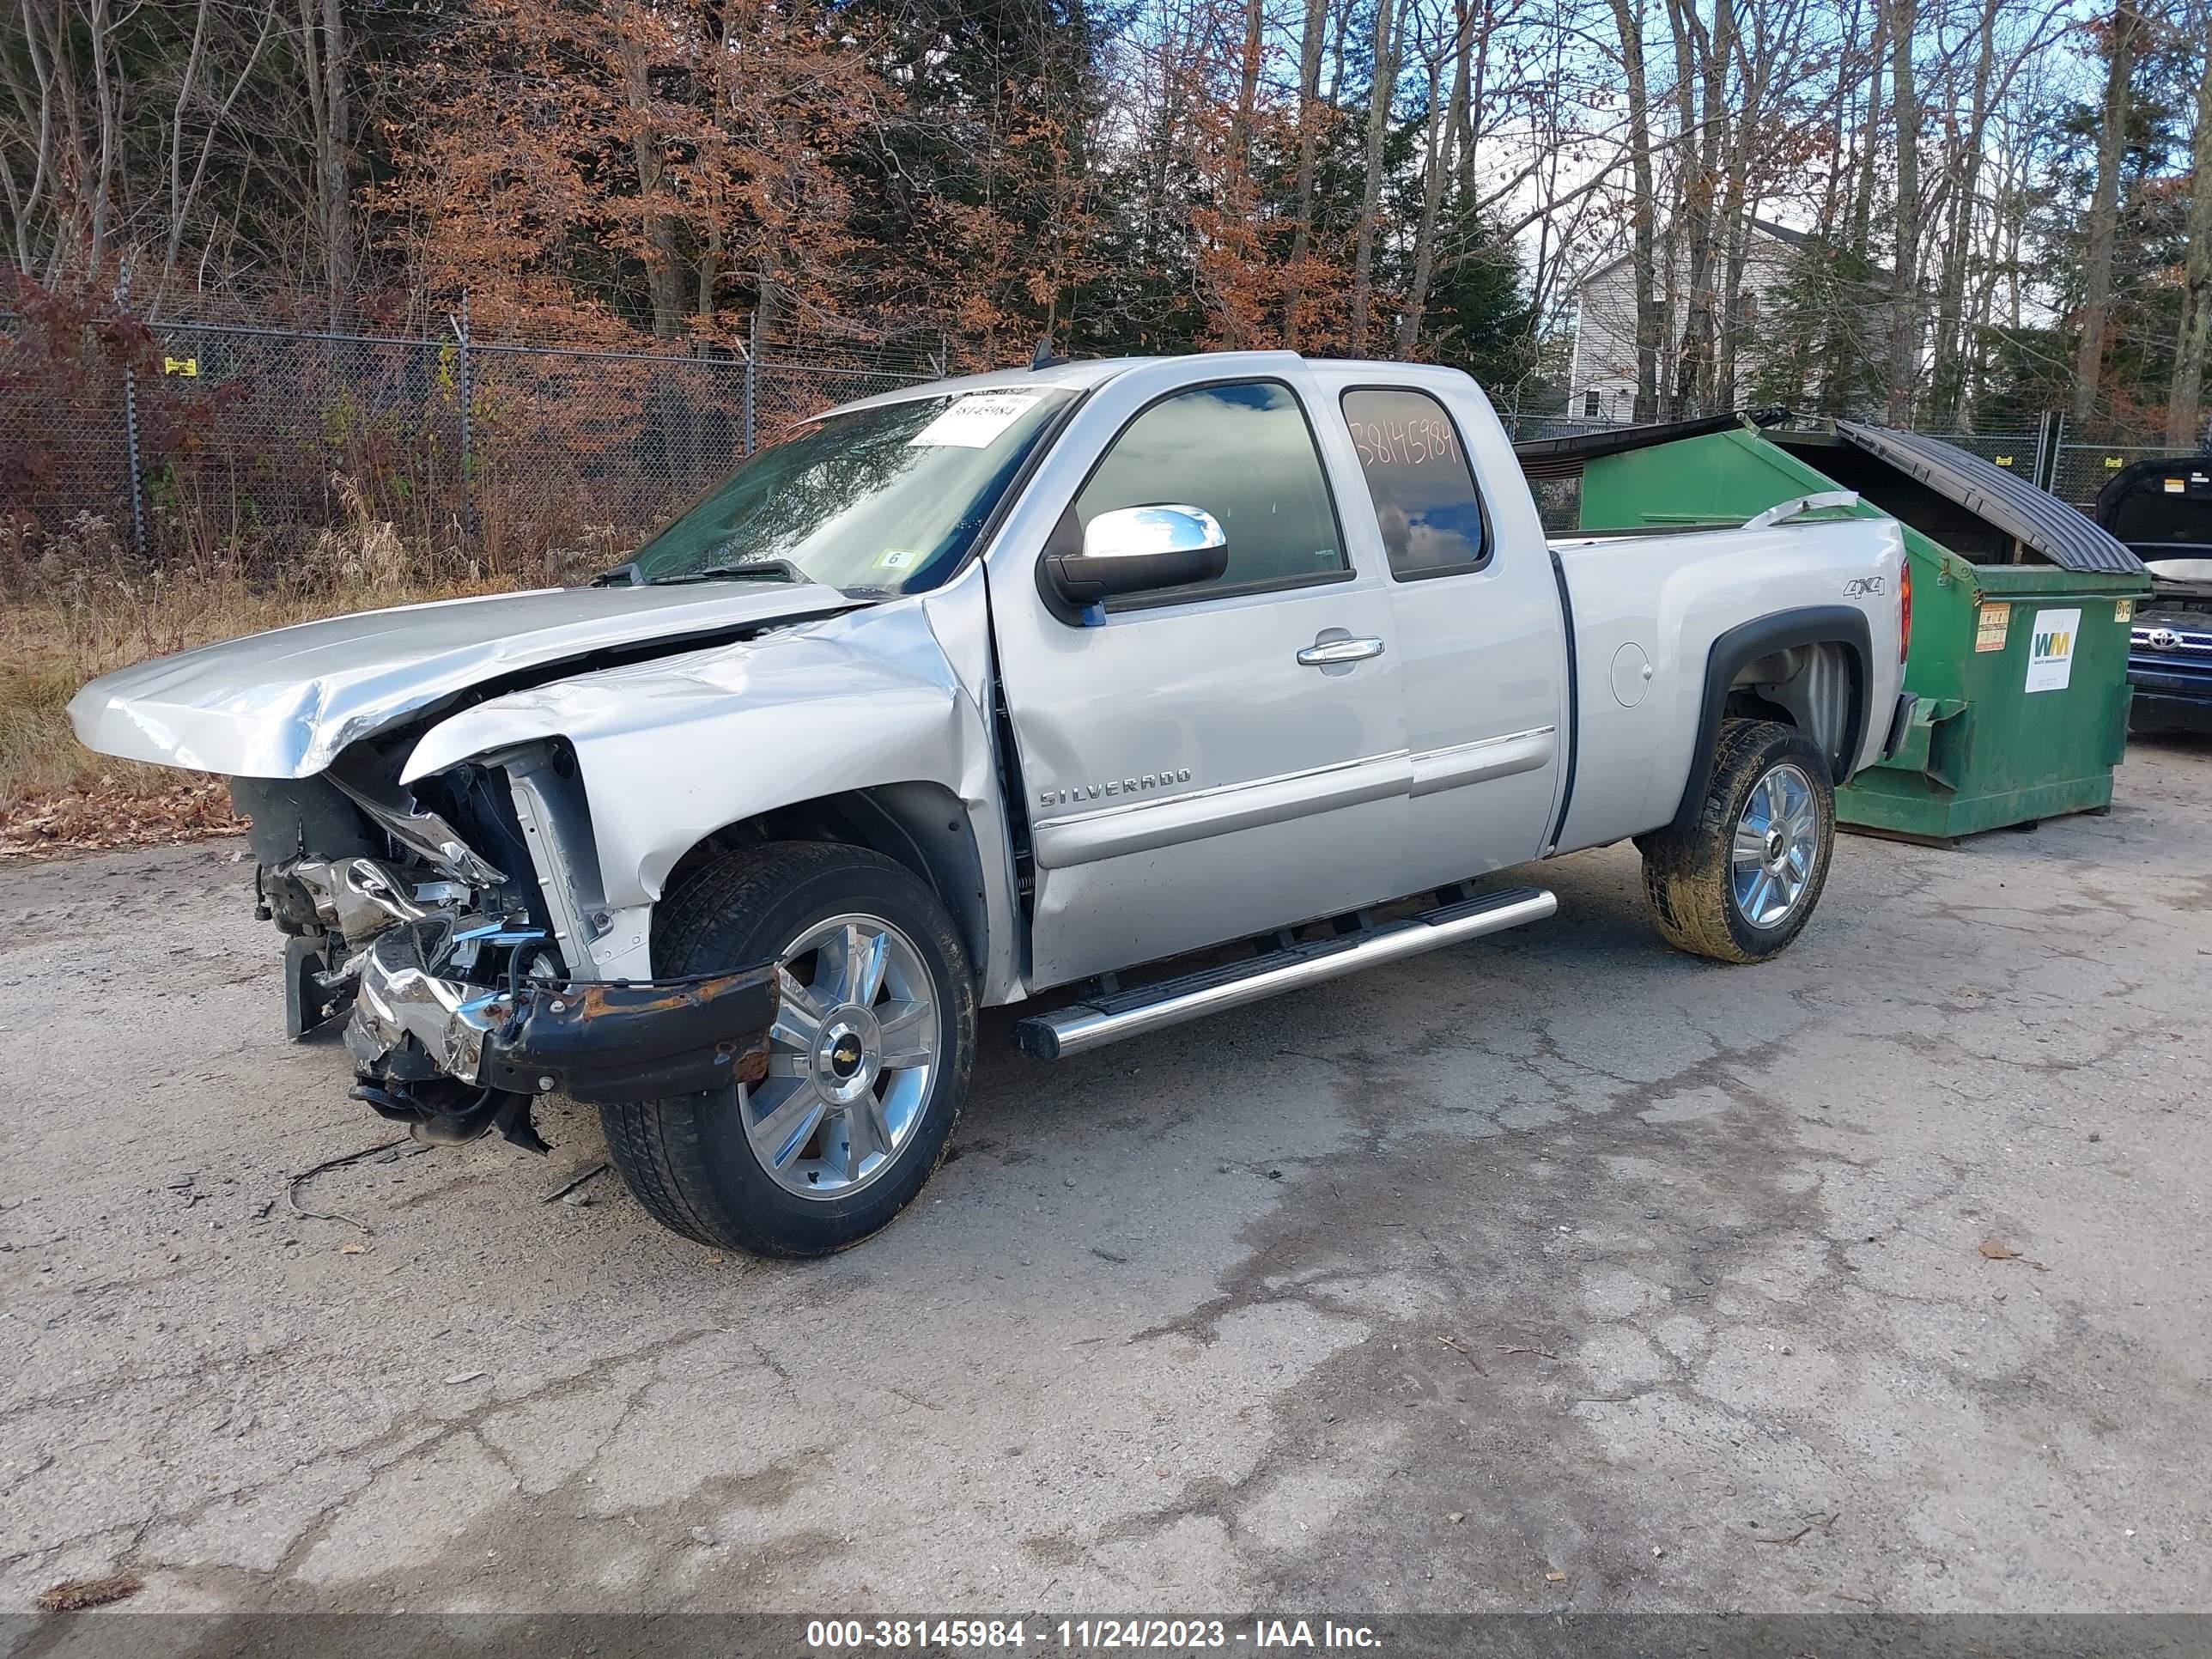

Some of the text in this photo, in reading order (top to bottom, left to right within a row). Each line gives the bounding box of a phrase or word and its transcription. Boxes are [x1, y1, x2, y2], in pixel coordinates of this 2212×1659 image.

[1349, 419, 1457, 466] 38145984
[889, 552, 901, 564] 6
[2034, 632, 2070, 658] WM
[1040, 768, 1193, 808] SILVERADO
